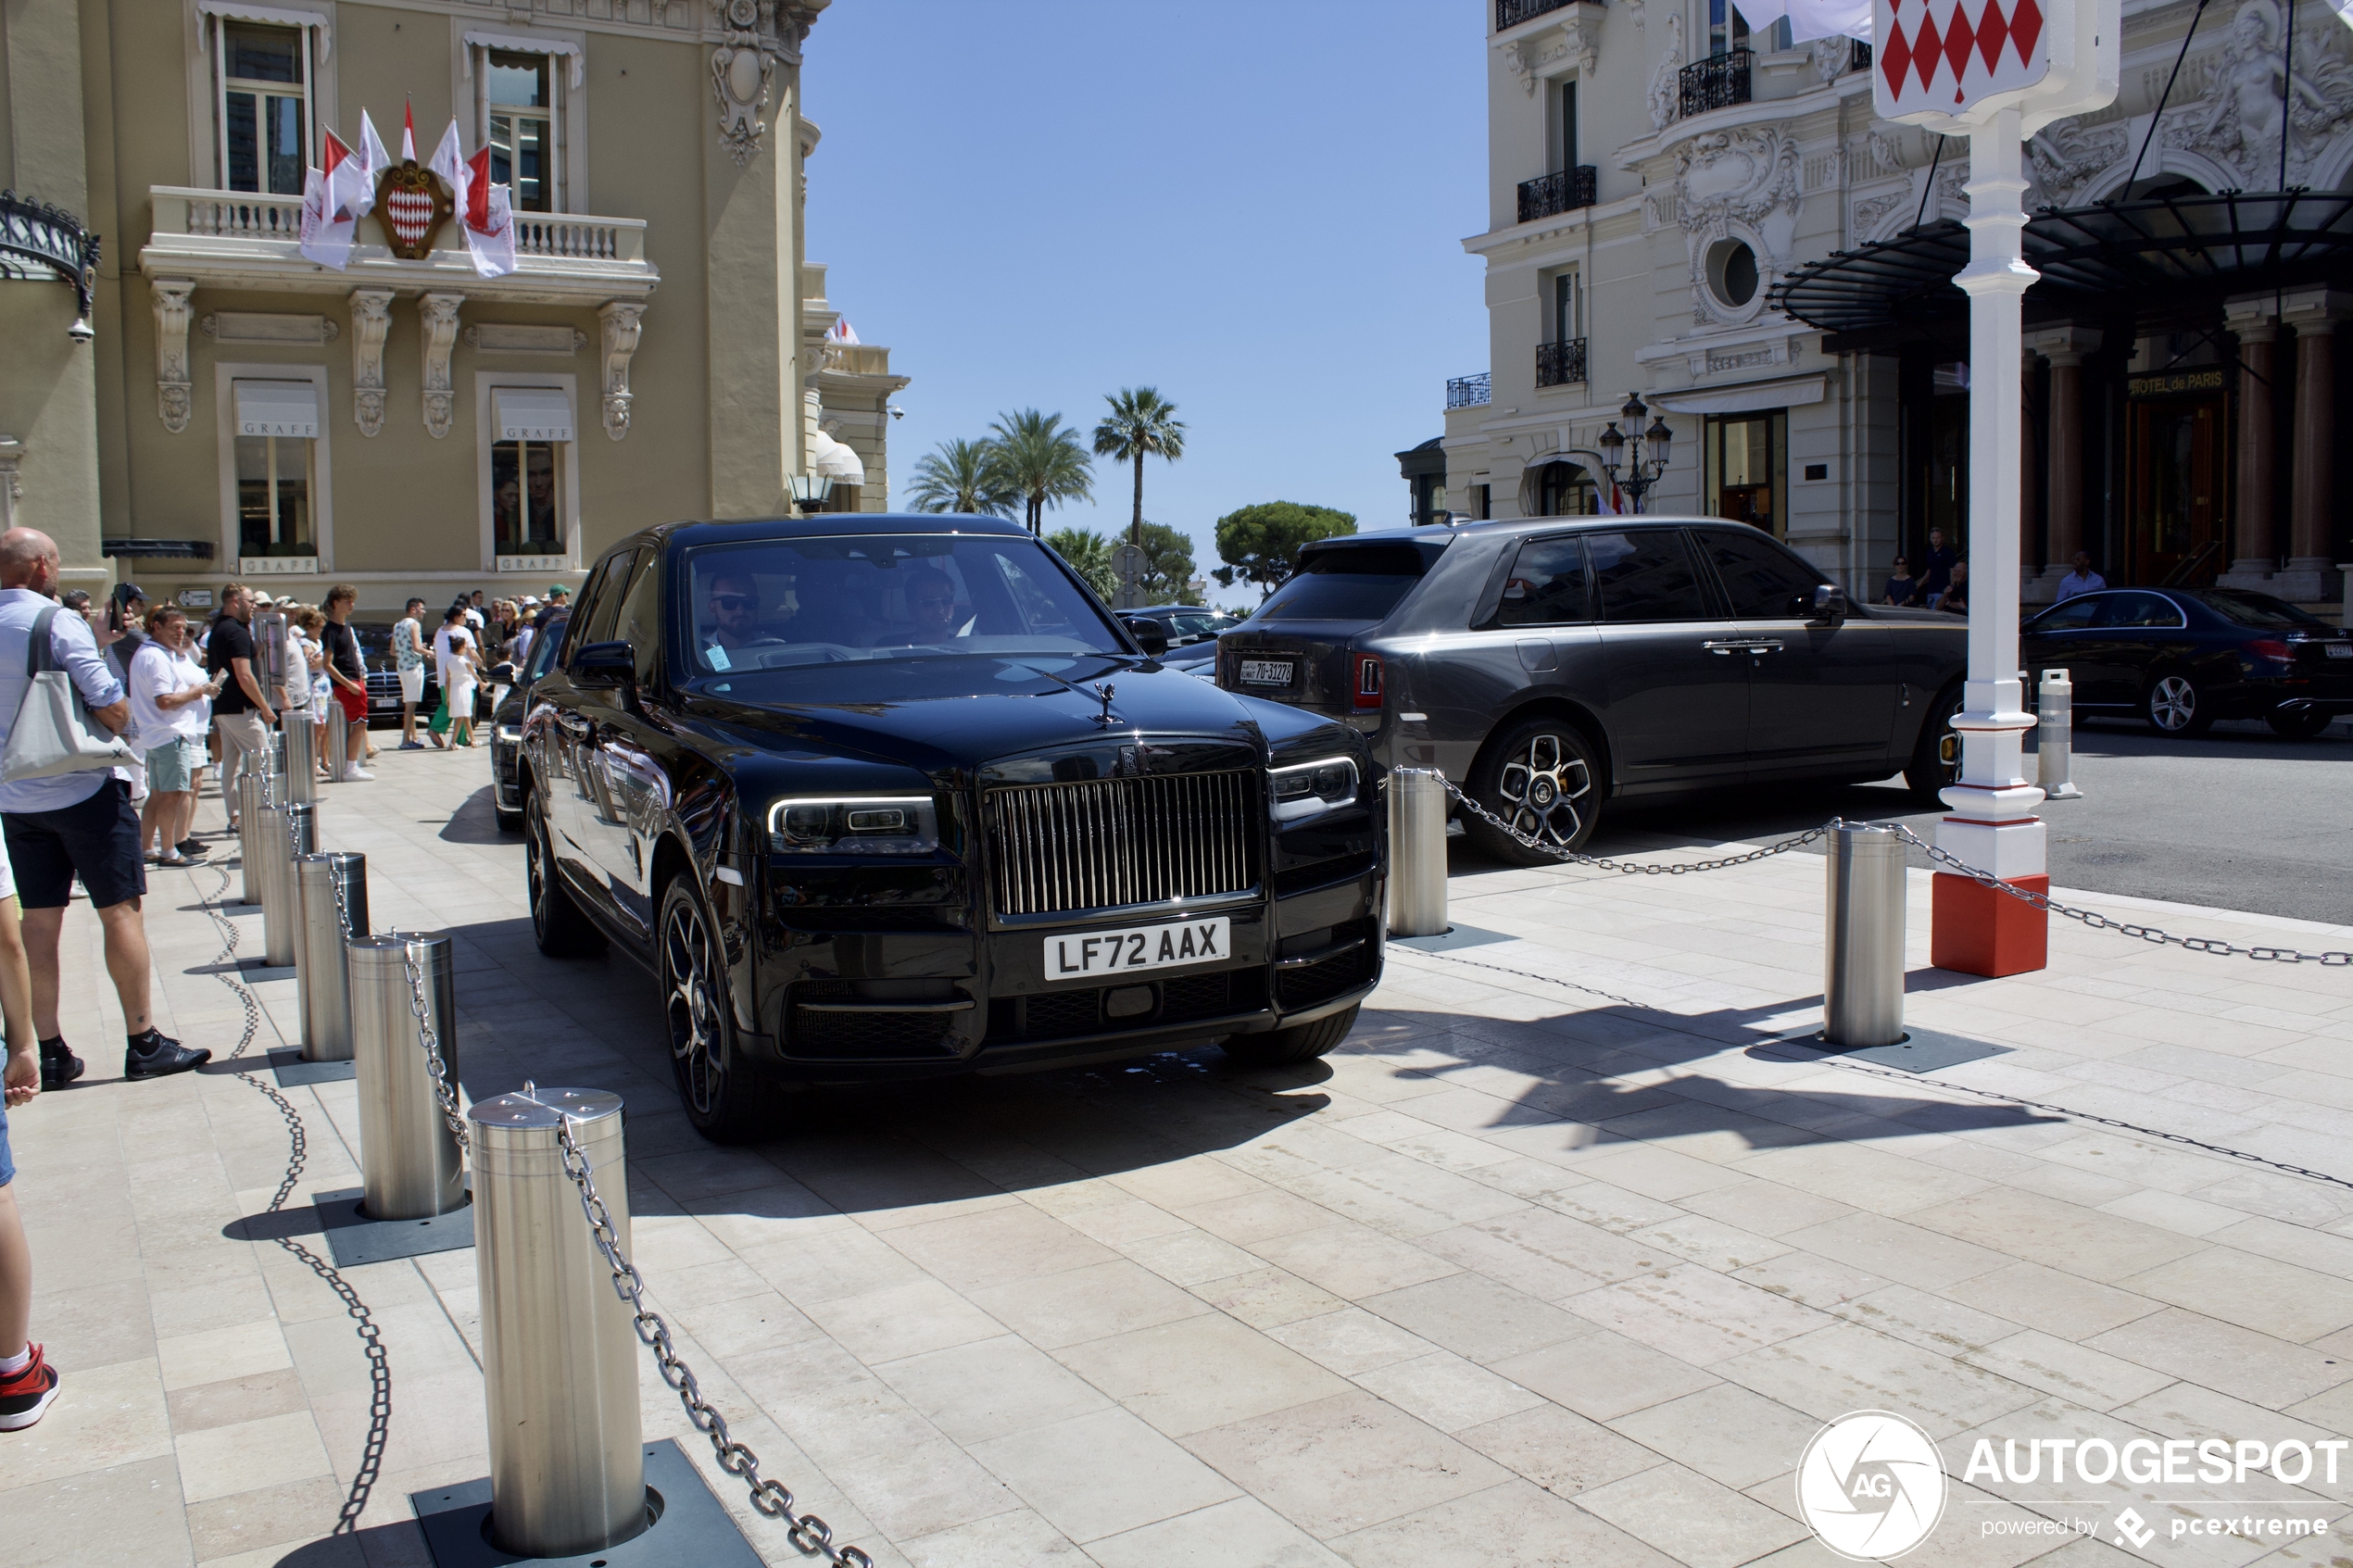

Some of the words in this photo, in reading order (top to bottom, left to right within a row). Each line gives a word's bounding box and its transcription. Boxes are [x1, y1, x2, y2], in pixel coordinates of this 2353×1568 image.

[2132, 377, 2169, 395] HOTEL
[2172, 376, 2185, 390] de
[2188, 371, 2222, 388] PARIS
[244, 422, 313, 434] GRAFF
[507, 428, 569, 438] GRAFF
[245, 559, 312, 572] GRAFF
[502, 558, 562, 570] GRAFF
[1256, 663, 1292, 681] 70-31278
[1058, 933, 1146, 973] LF72
[1158, 923, 1216, 961] AAX
